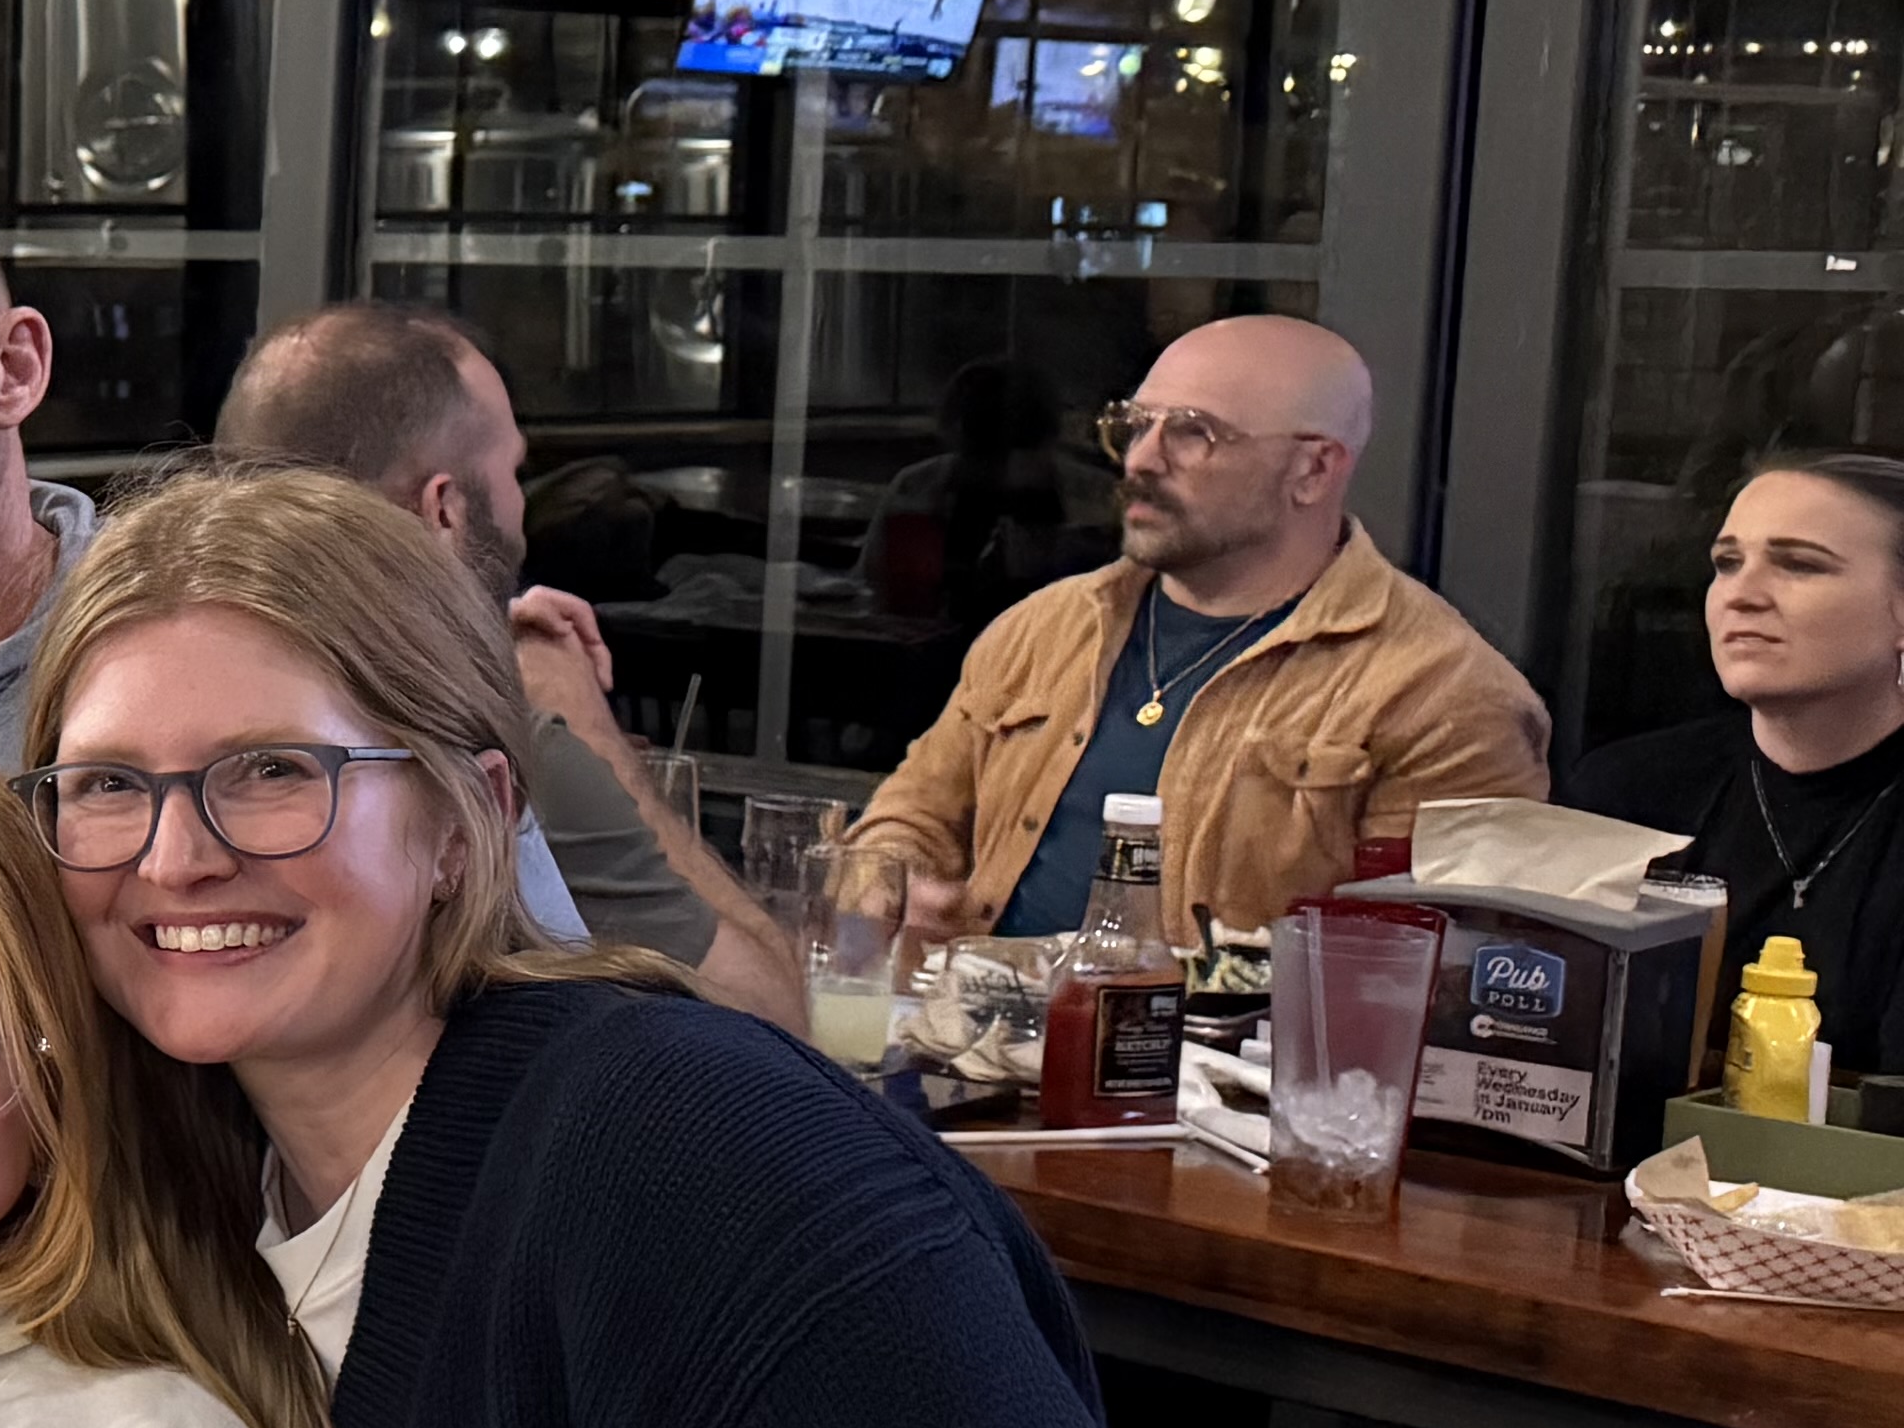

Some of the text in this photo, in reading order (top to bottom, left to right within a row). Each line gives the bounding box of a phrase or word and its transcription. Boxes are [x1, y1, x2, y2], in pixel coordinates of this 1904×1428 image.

[1487, 956, 1550, 990] Pub
[1488, 991, 1546, 1012] POLL
[1477, 1060, 1527, 1083] Every
[1476, 1076, 1580, 1108] Wednesday
[1494, 1095, 1573, 1121] January
